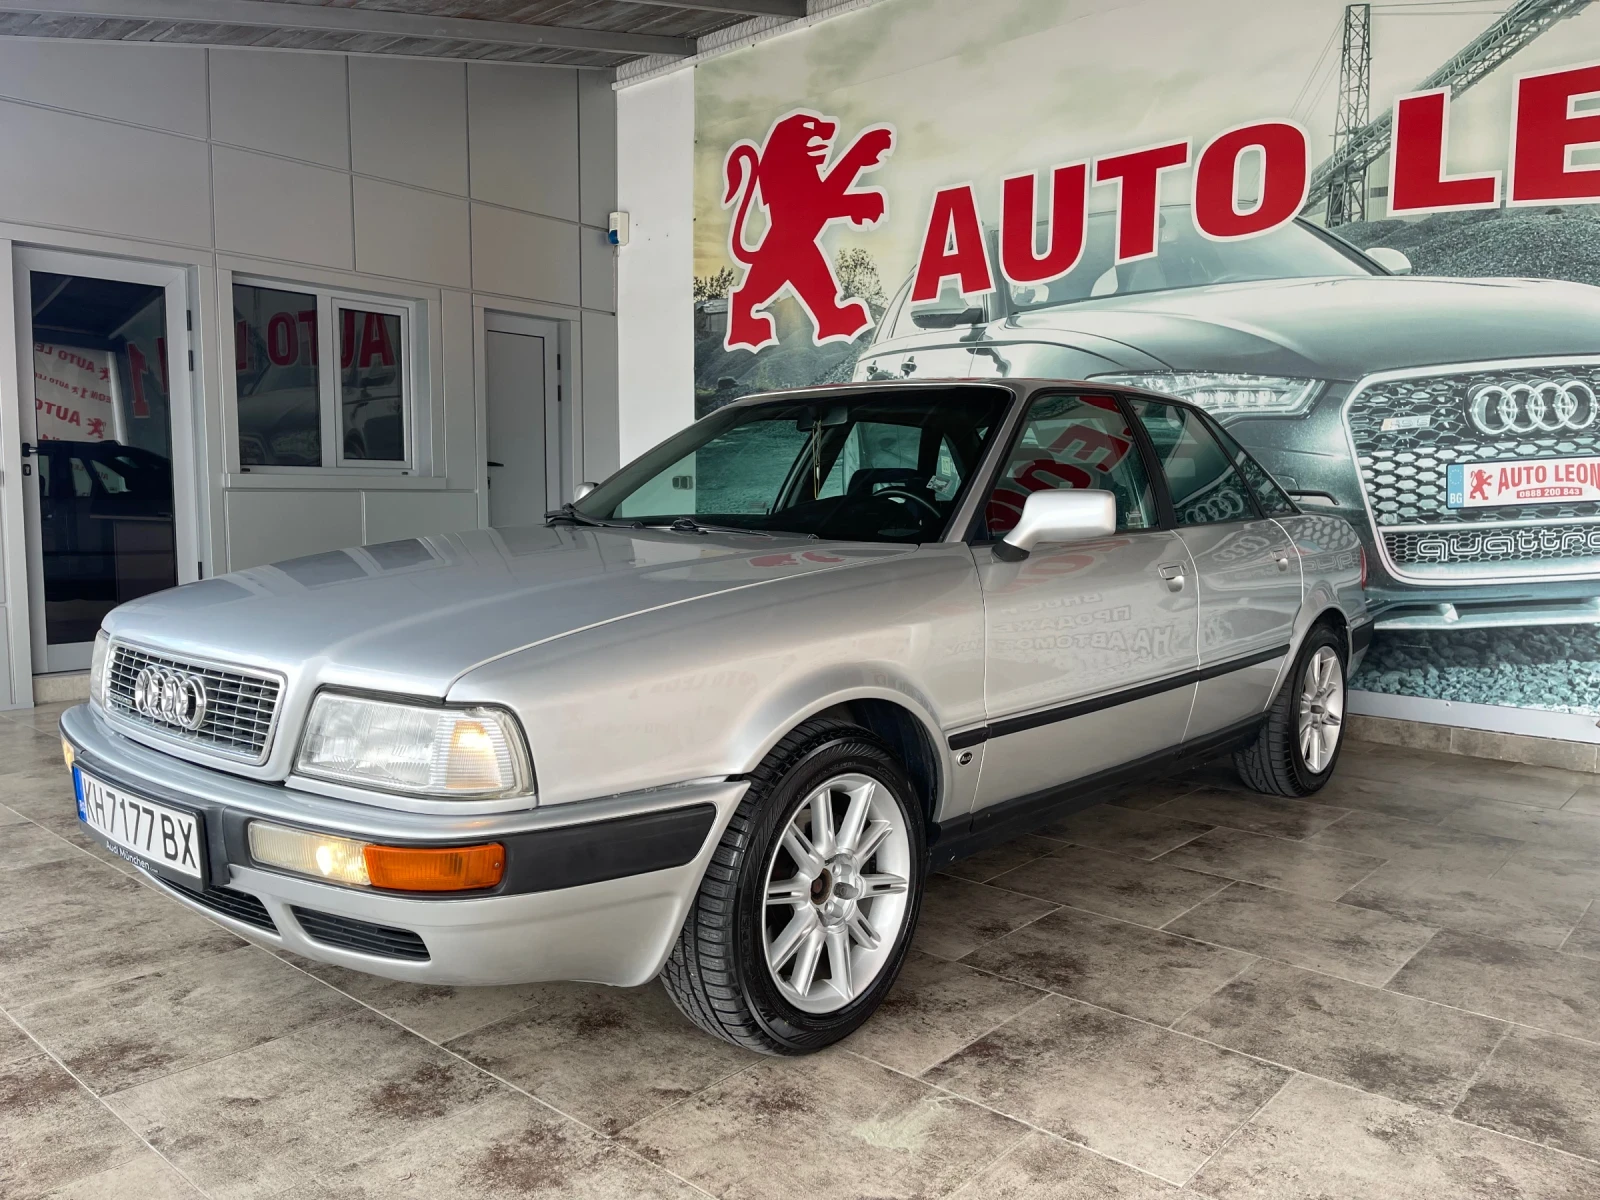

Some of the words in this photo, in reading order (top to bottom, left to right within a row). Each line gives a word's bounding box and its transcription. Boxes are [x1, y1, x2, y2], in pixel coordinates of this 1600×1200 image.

[910, 120, 1309, 303] AUTO
[1498, 465, 1547, 497] AUTO
[1544, 488, 1560, 496] 200
[1450, 493, 1463, 504] BG
[106, 840, 119, 855] Audi
[119, 848, 150, 870] München
